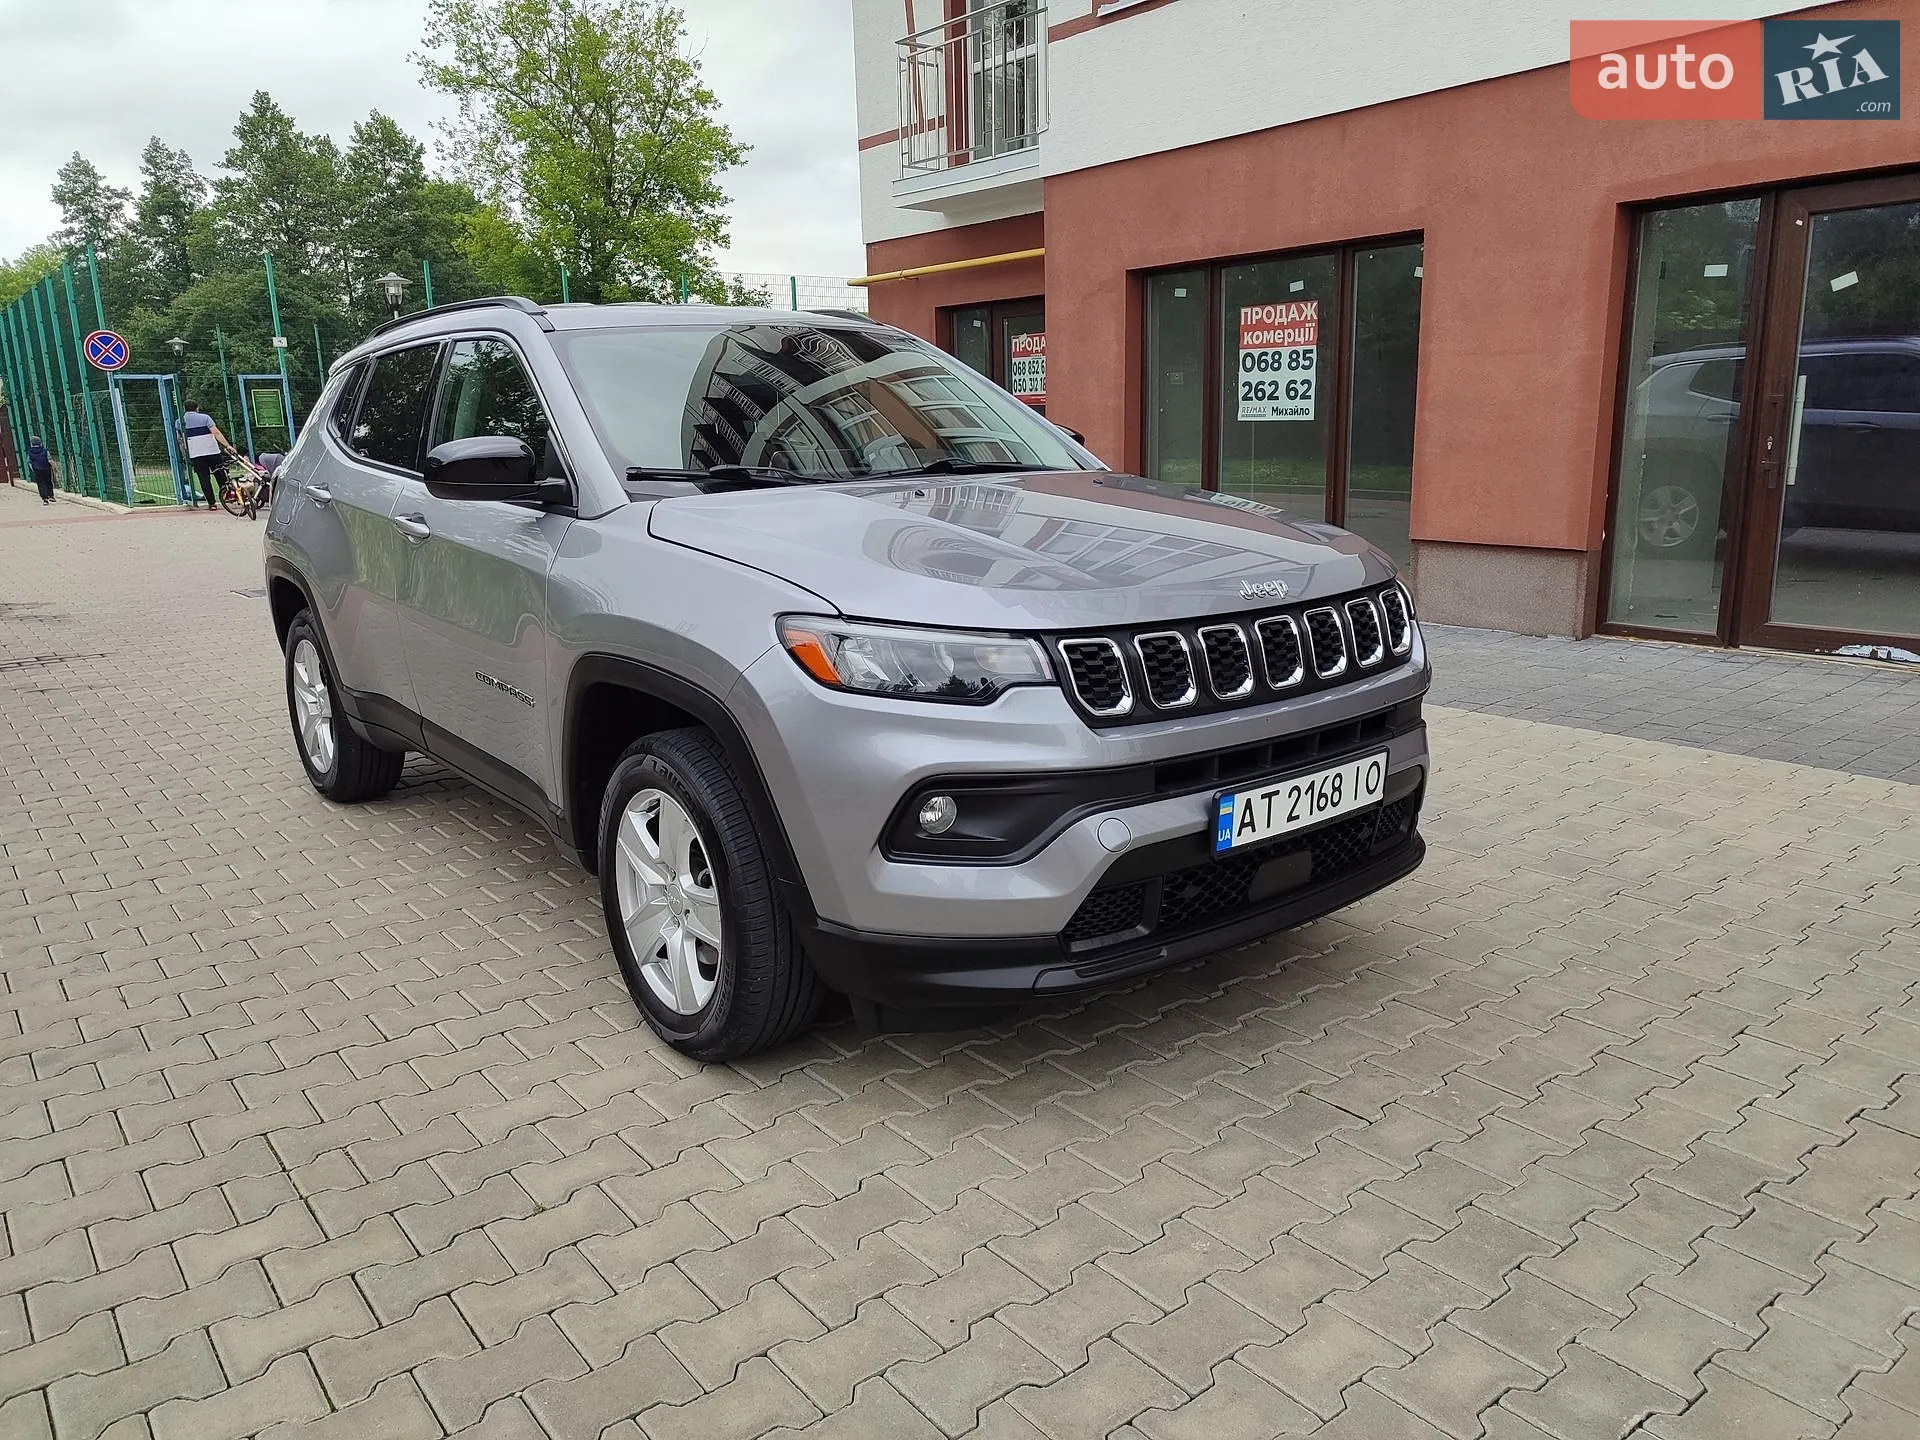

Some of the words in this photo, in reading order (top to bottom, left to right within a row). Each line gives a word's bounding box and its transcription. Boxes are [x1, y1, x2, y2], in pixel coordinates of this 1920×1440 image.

[1241, 301, 1318, 326] ПРОДАЖ
[1243, 323, 1316, 346] комерції
[1013, 361, 1026, 376] 068
[1027, 360, 1039, 375] 852
[1242, 350, 1282, 373] 068
[1287, 349, 1314, 371] 85
[1013, 378, 1027, 393] 050
[1029, 377, 1038, 392] 312
[1241, 380, 1279, 401] 262
[1285, 379, 1312, 400] 62
[1271, 405, 1310, 416] Михайло
[1239, 580, 1288, 601] Jeep
[475, 670, 535, 707] COMPASS
[1236, 790, 1280, 837] AT
[1286, 772, 1343, 823] 2168
[1218, 829, 1231, 842] UA
